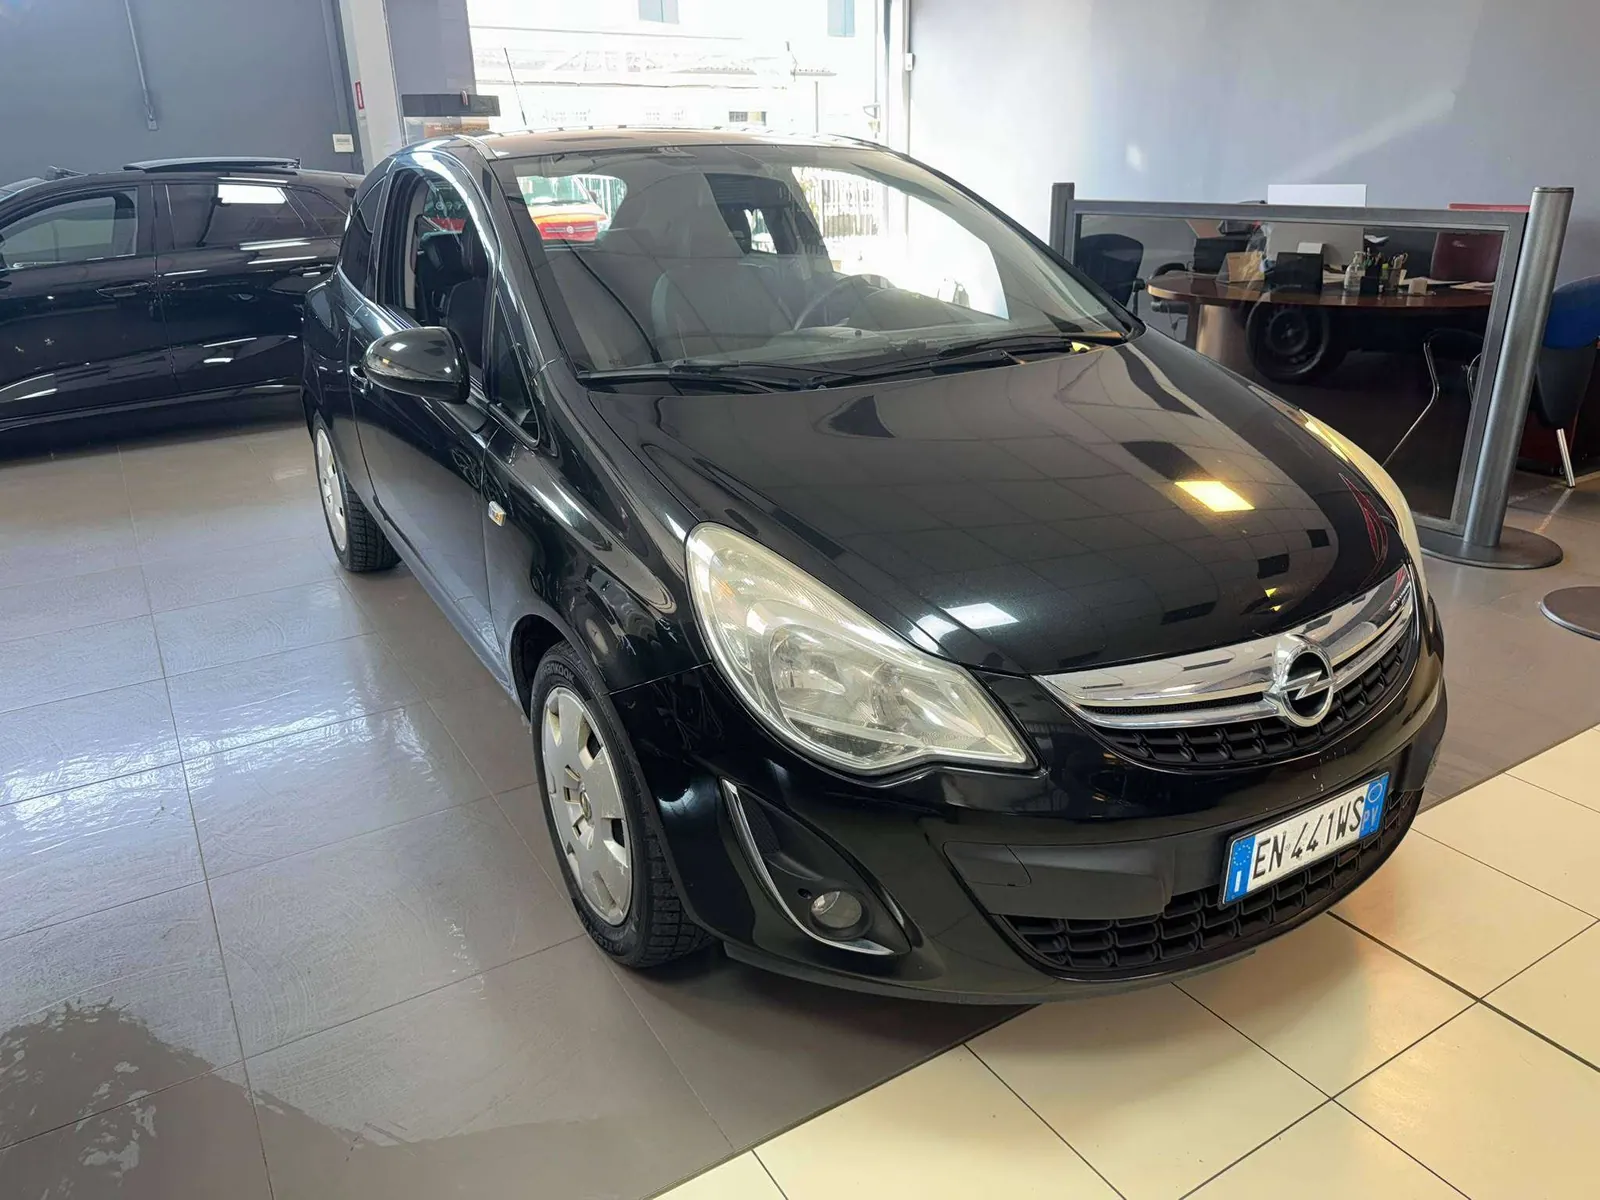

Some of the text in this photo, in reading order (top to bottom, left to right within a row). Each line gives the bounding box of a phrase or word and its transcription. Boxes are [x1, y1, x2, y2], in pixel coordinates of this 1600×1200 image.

[1252, 795, 1365, 880] EN 441WS
[1234, 870, 1243, 893] I
